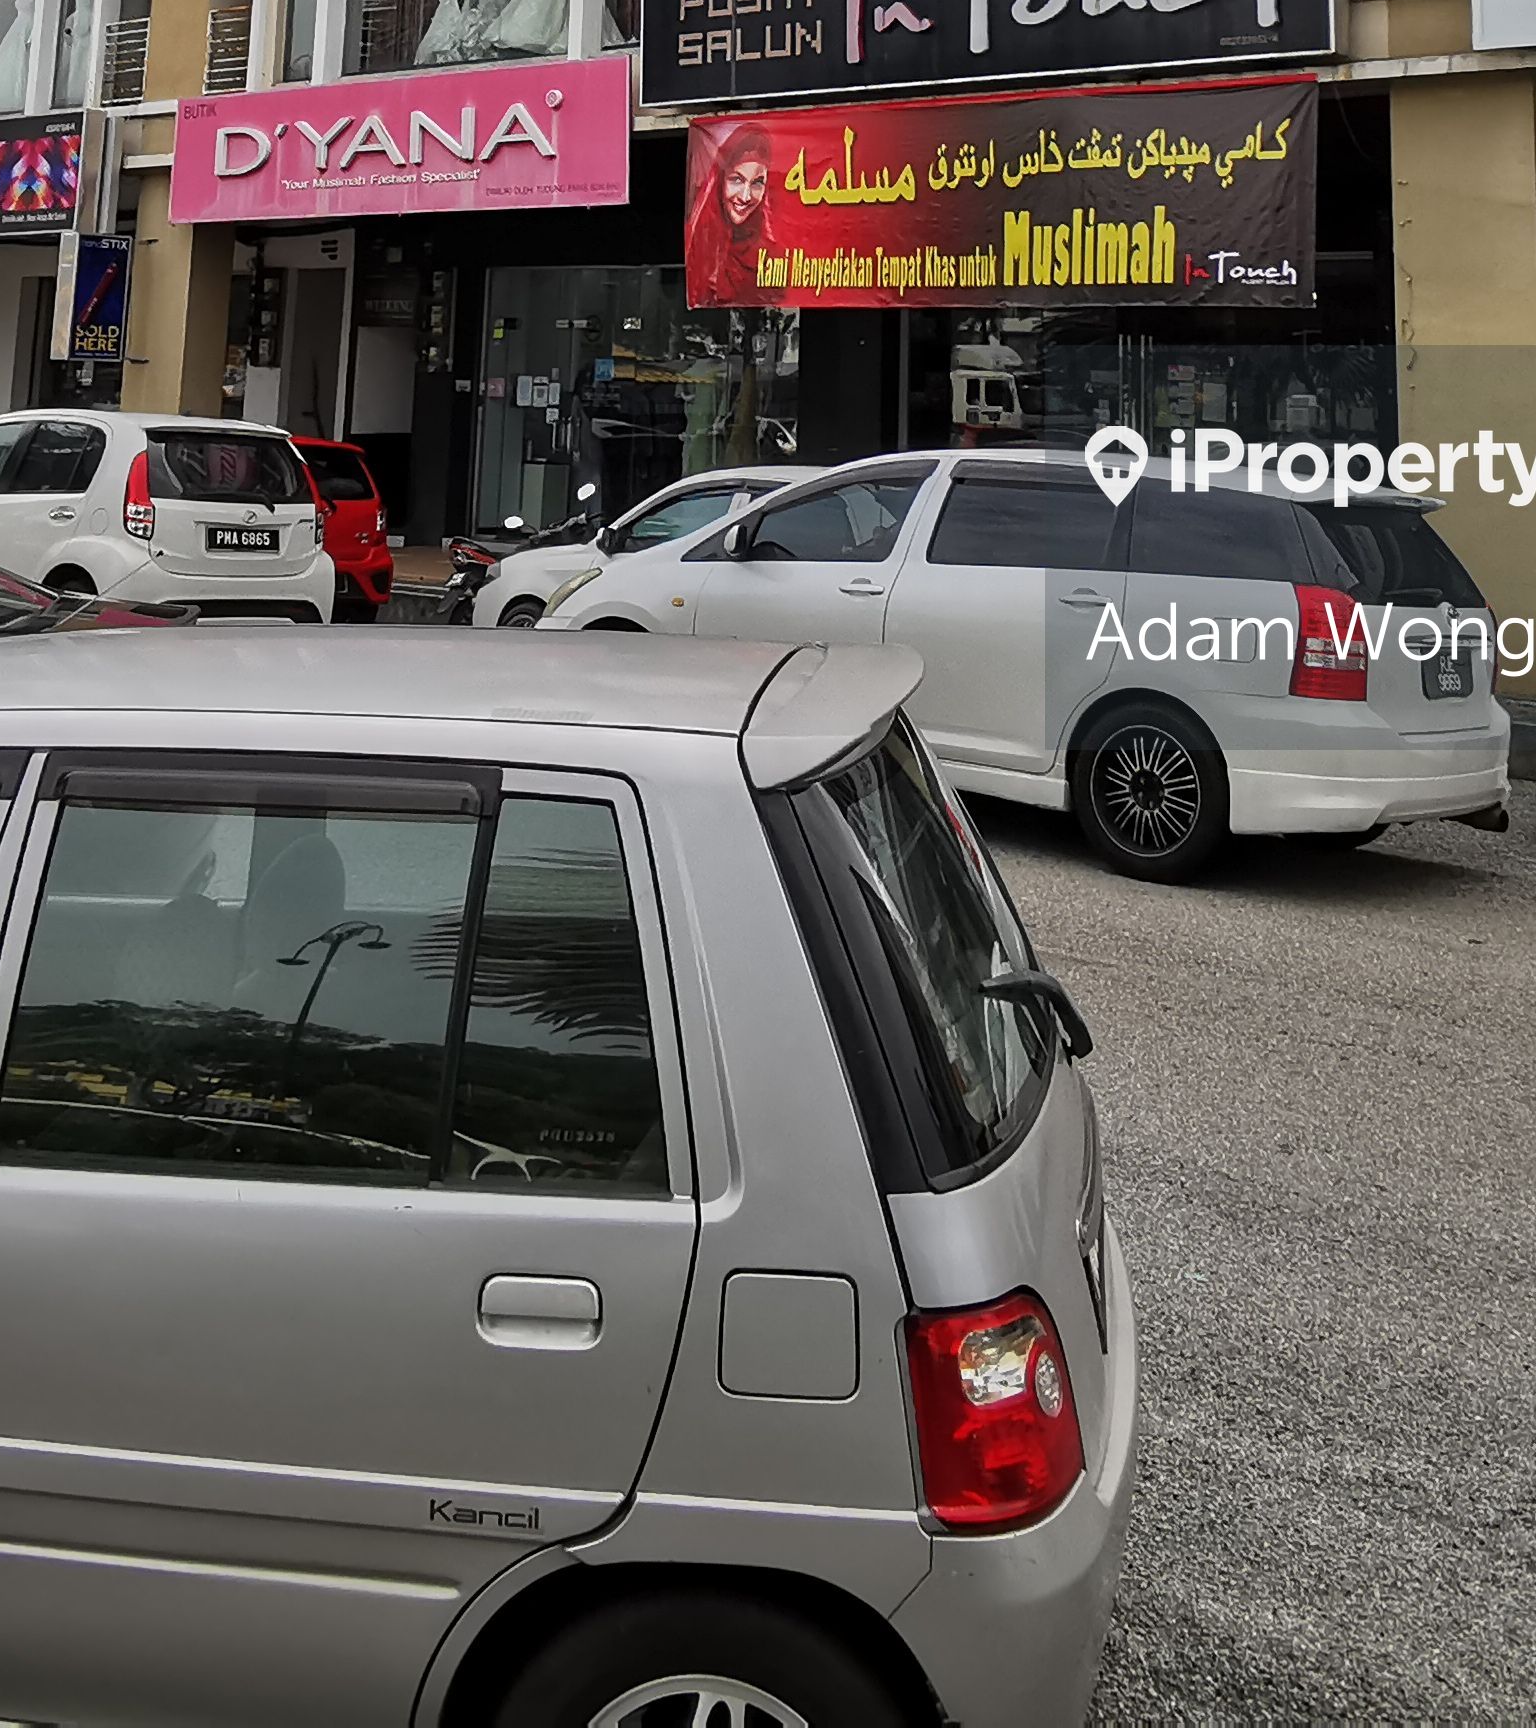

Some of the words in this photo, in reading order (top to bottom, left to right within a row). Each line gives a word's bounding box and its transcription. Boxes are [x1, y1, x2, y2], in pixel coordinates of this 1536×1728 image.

[678, 23, 823, 68] SALUN
[183, 103, 218, 120] BUTIK
[214, 103, 558, 177] D'YANA
[312, 175, 366, 190] Muslimah
[370, 172, 417, 185] Fashion
[756, 247, 790, 288] Kami
[791, 247, 873, 297] Menyediakan
[875, 245, 922, 297] Tempat
[924, 245, 956, 288] Khas
[959, 243, 997, 288] untuk
[1002, 204, 1176, 288] Muslimah
[1207, 249, 1298, 286] Touch
[75, 325, 120, 338] SOLD
[74, 338, 118, 352] HERE
[242, 531, 270, 546] 6865
[429, 1498, 540, 1530] Kancil
